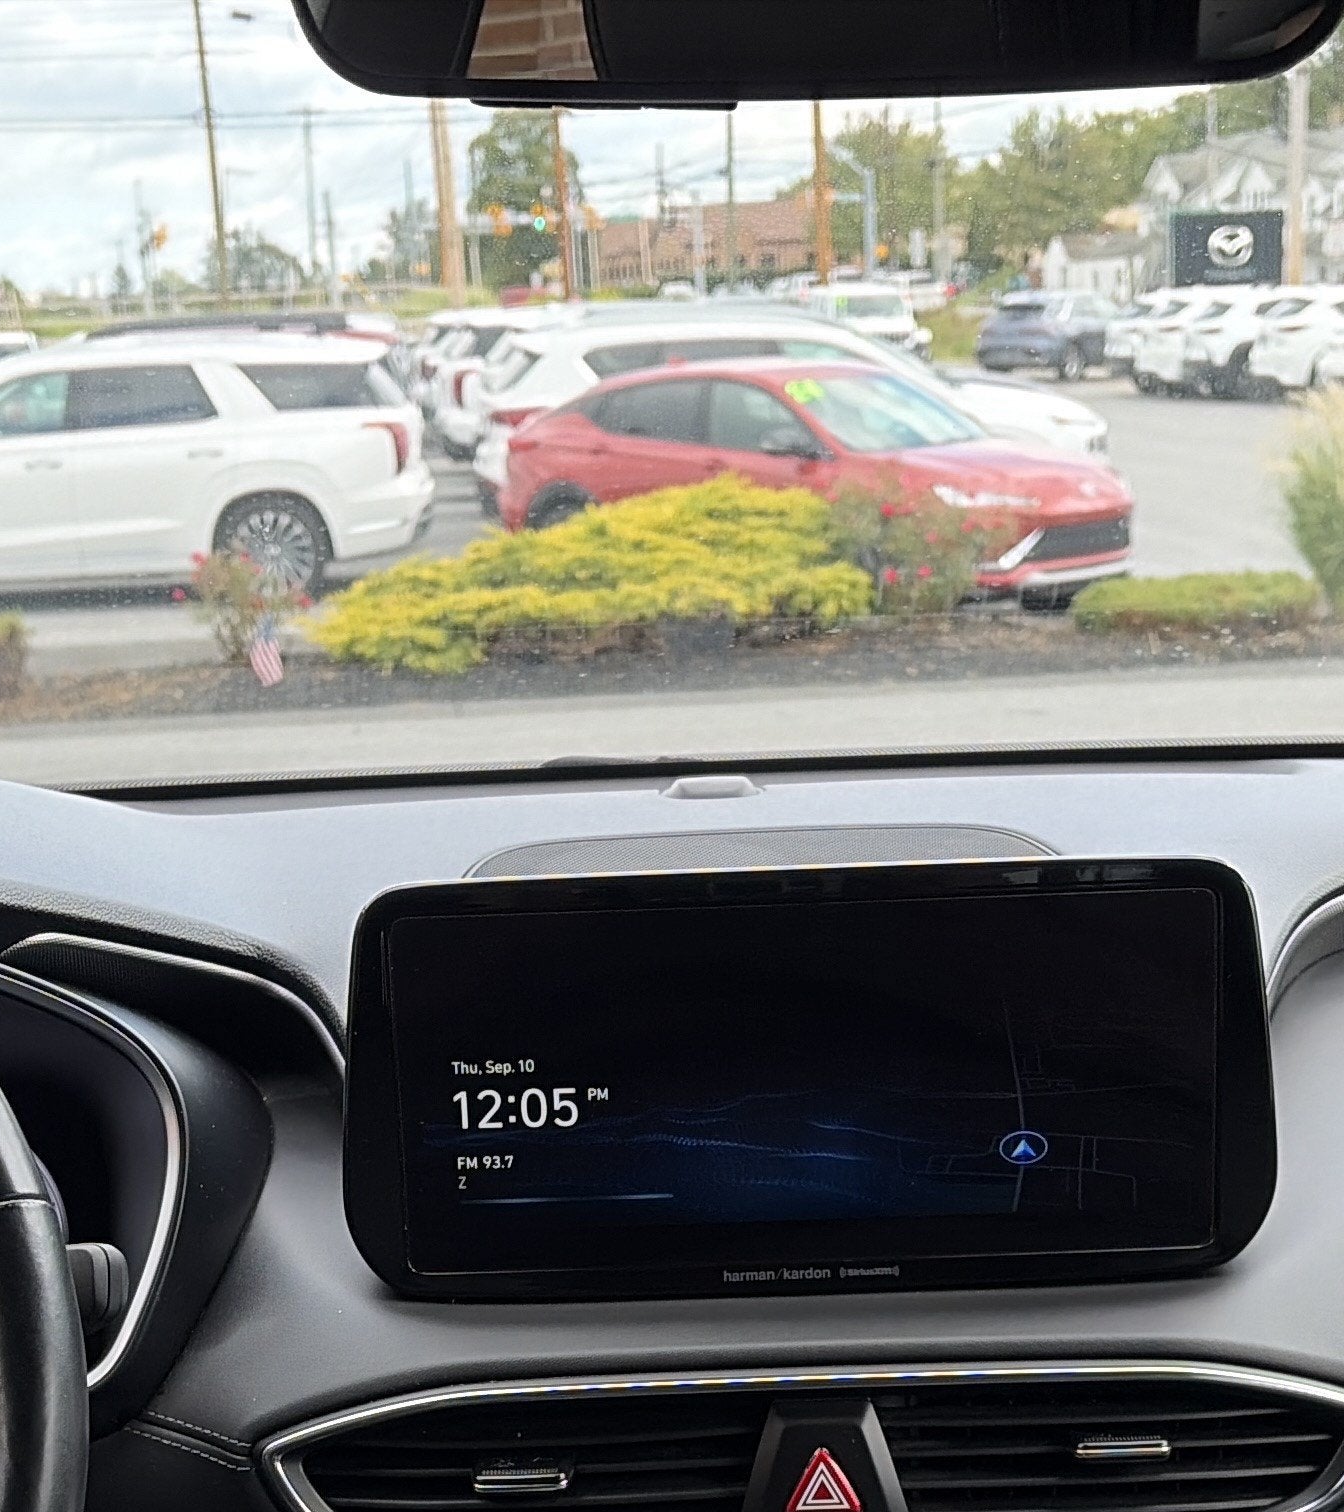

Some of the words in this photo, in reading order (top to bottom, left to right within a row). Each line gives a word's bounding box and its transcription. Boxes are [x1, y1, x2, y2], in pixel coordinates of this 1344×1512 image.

[451, 1061, 483, 1075] Thu,
[485, 1060, 515, 1076] Sep.
[518, 1059, 535, 1073] 10
[452, 1087, 579, 1130] 12:05
[587, 1087, 609, 1101] PM
[457, 1156, 478, 1170] FM
[482, 1155, 514, 1169] 93.7
[458, 1176, 467, 1189] Z
[723, 1267, 831, 1282] harman/kardon
